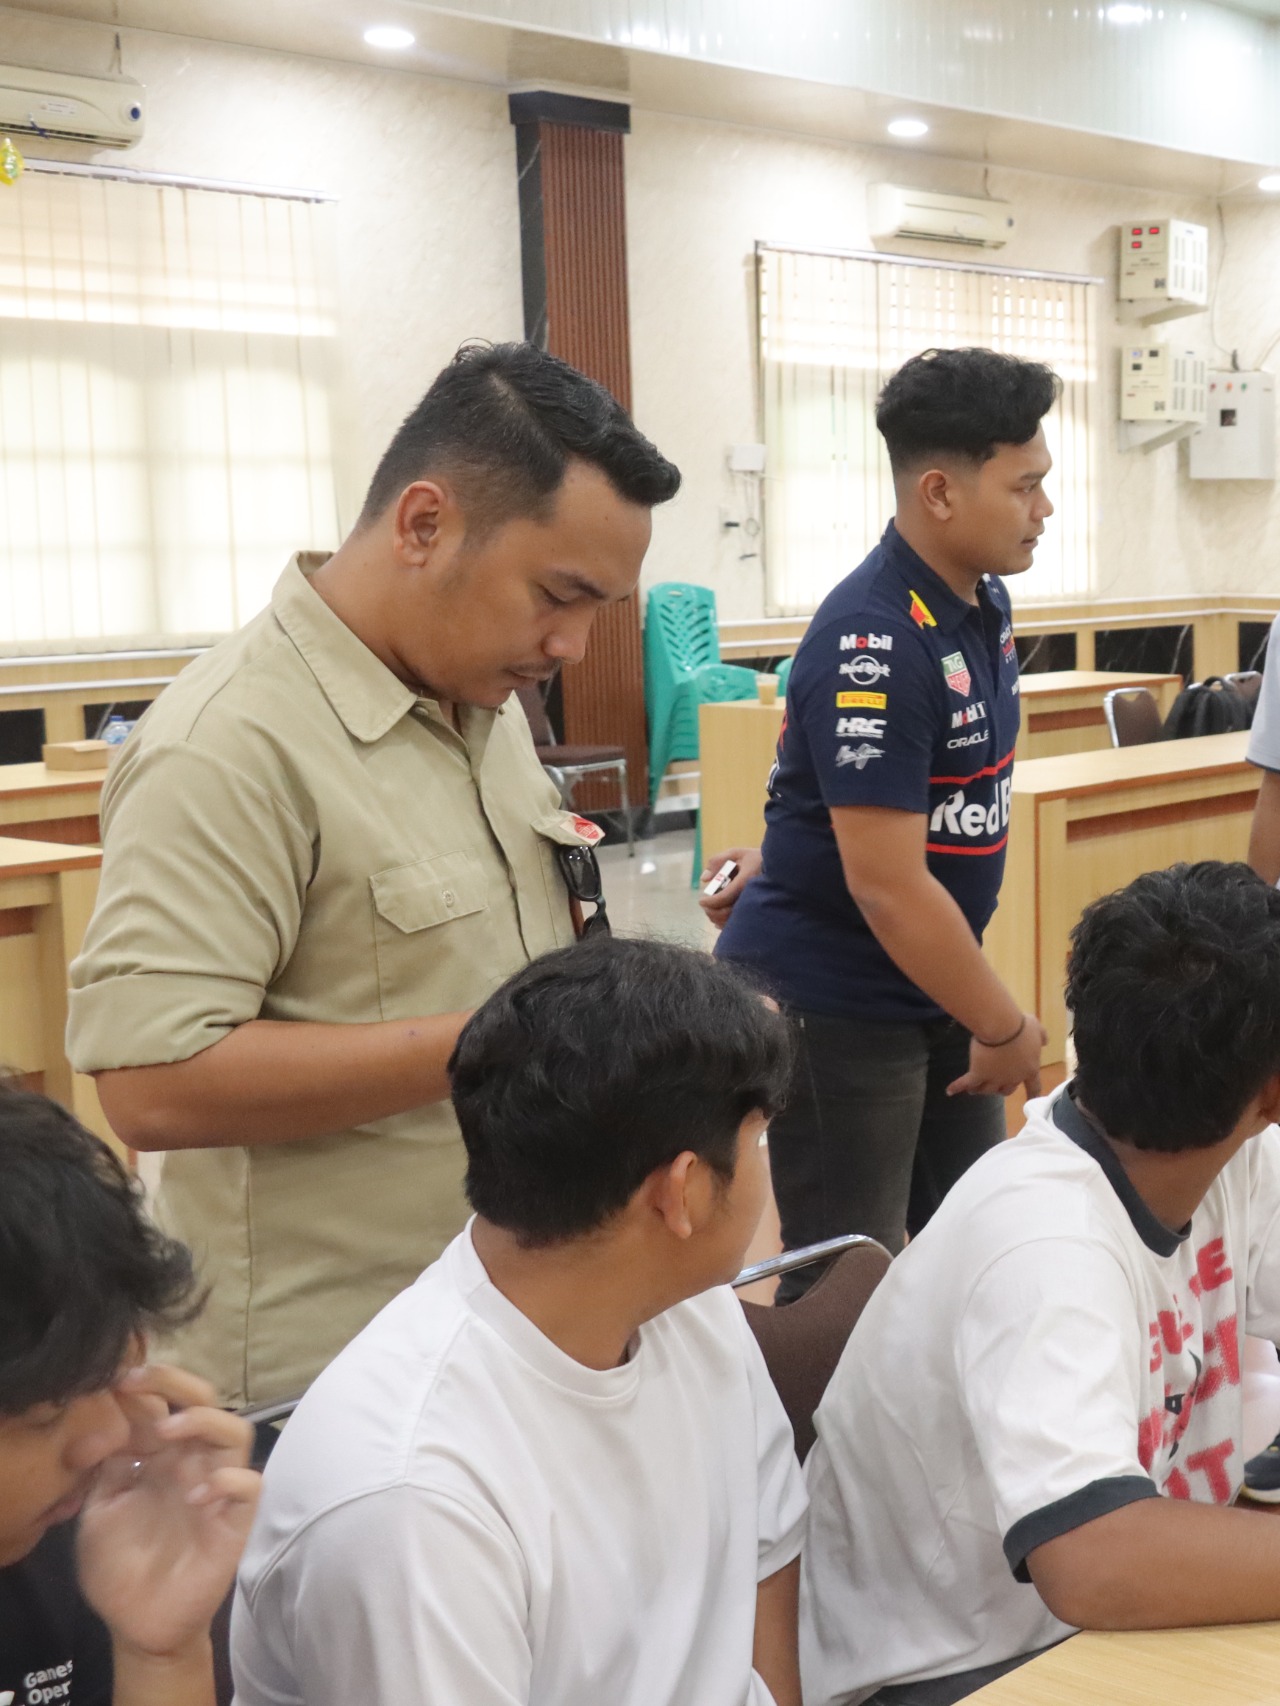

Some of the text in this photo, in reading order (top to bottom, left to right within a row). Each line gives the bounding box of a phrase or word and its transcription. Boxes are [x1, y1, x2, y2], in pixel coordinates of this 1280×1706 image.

[839, 632, 893, 651] Mobil
[836, 717, 887, 734] HRC
[947, 729, 989, 749] ORACLE
